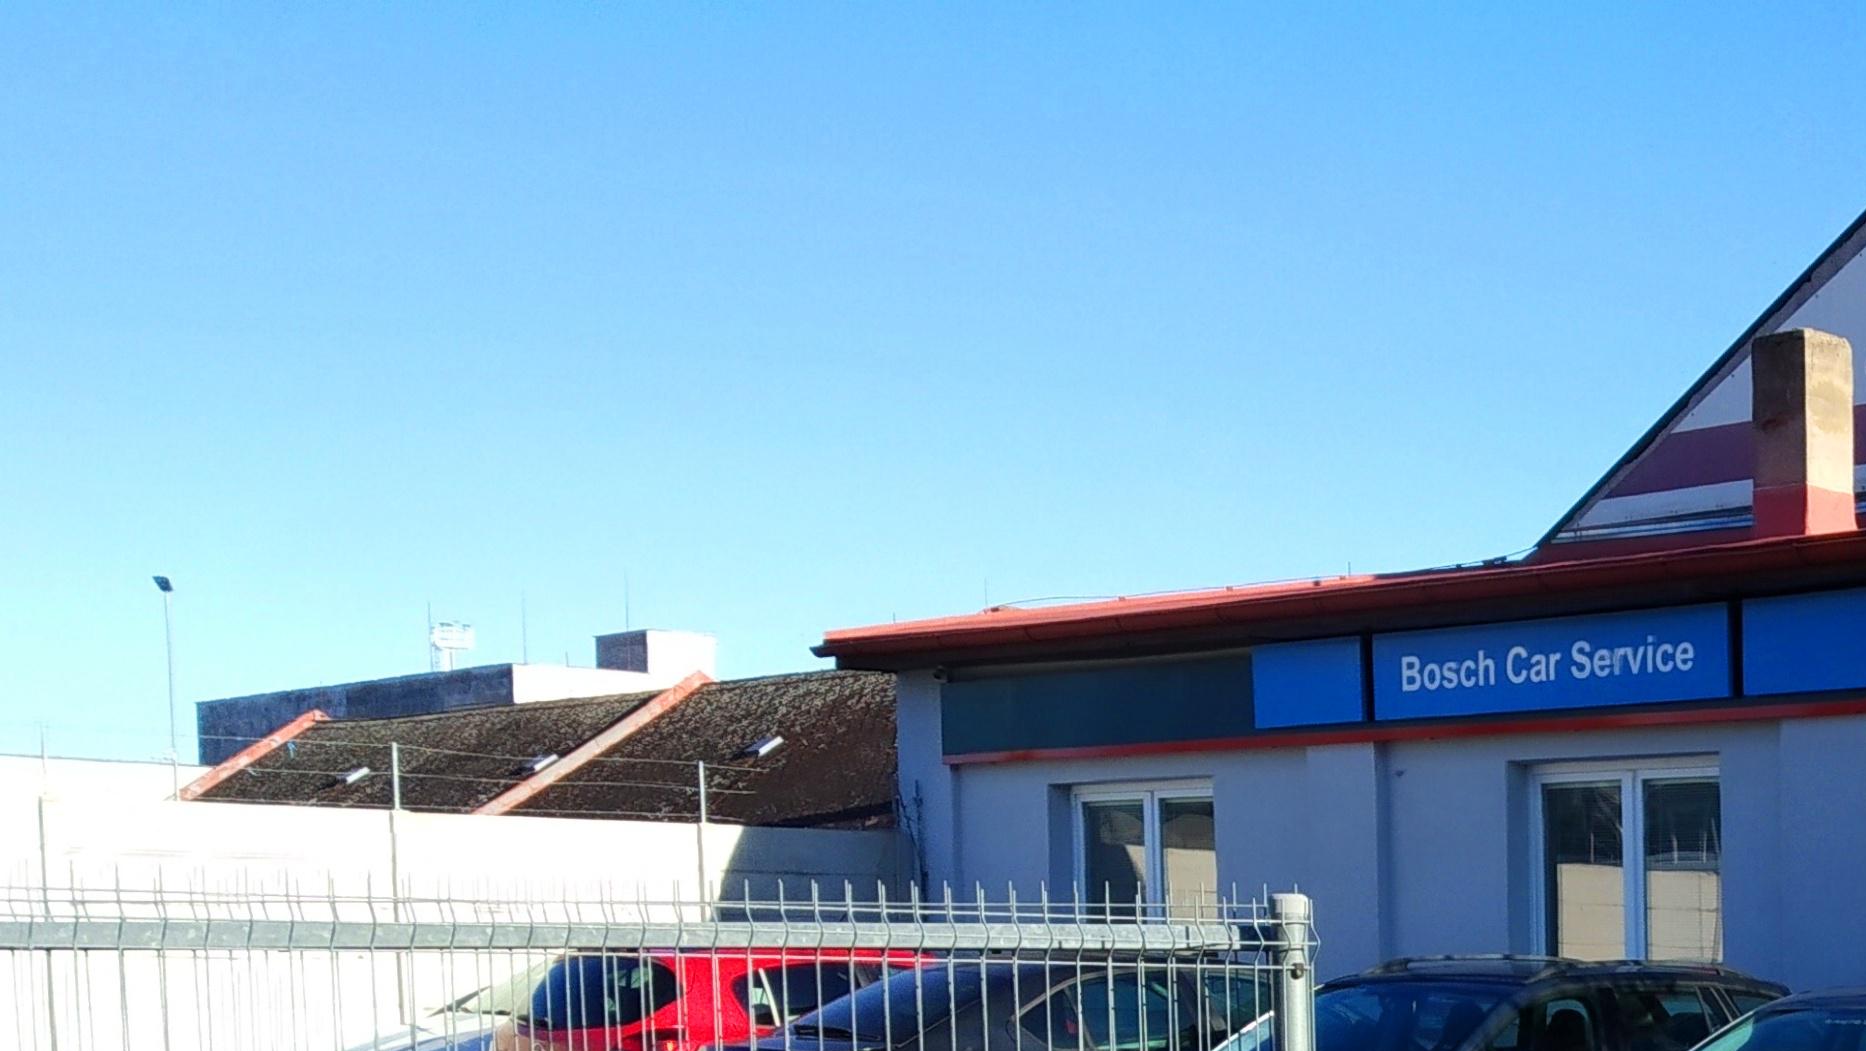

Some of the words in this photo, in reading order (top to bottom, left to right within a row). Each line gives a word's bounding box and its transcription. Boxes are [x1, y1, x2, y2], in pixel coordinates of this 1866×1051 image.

[1400, 650, 1496, 692] Bosch
[1506, 646, 1562, 684] Car
[1570, 635, 1695, 680] Service
